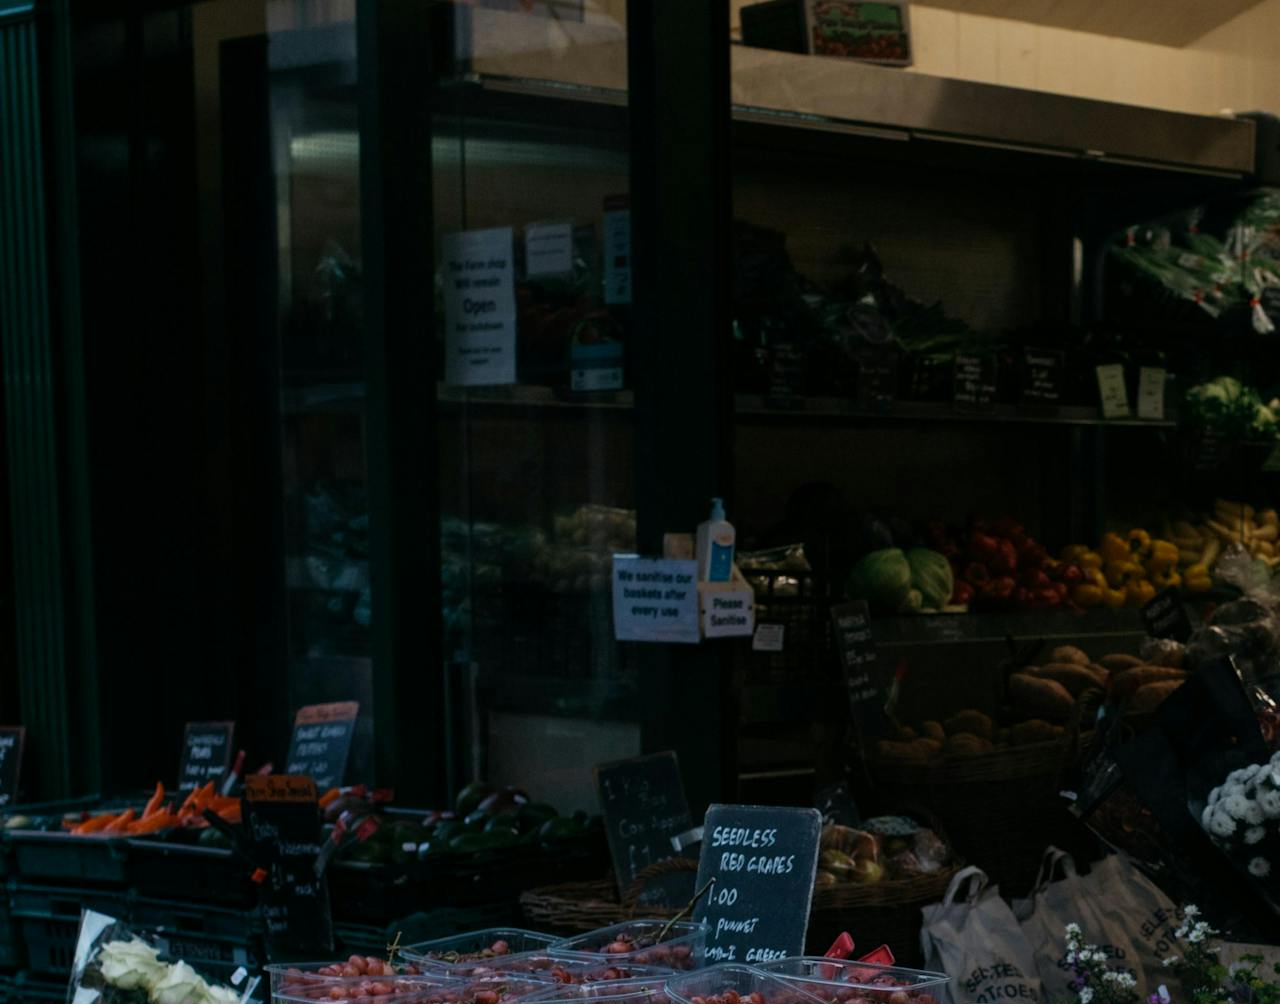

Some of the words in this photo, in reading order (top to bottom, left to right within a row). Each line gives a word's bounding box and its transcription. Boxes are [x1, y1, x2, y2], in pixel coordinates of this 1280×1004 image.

[618, 571, 634, 581] We
[636, 571, 672, 582] sanitise
[676, 573, 693, 583] our
[624, 588, 662, 600] baskets
[664, 588, 687, 600] after
[713, 598, 744, 609] Please
[632, 607, 658, 619] every
[661, 609, 679, 617] use
[710, 614, 747, 626] Sanitise
[712, 826, 778, 848] SEEDLESS
[720, 852, 745, 872] RED
[747, 854, 796, 874] GRAPES
[708, 883, 738, 906] 1.00
[715, 917, 760, 941] PUNNET
